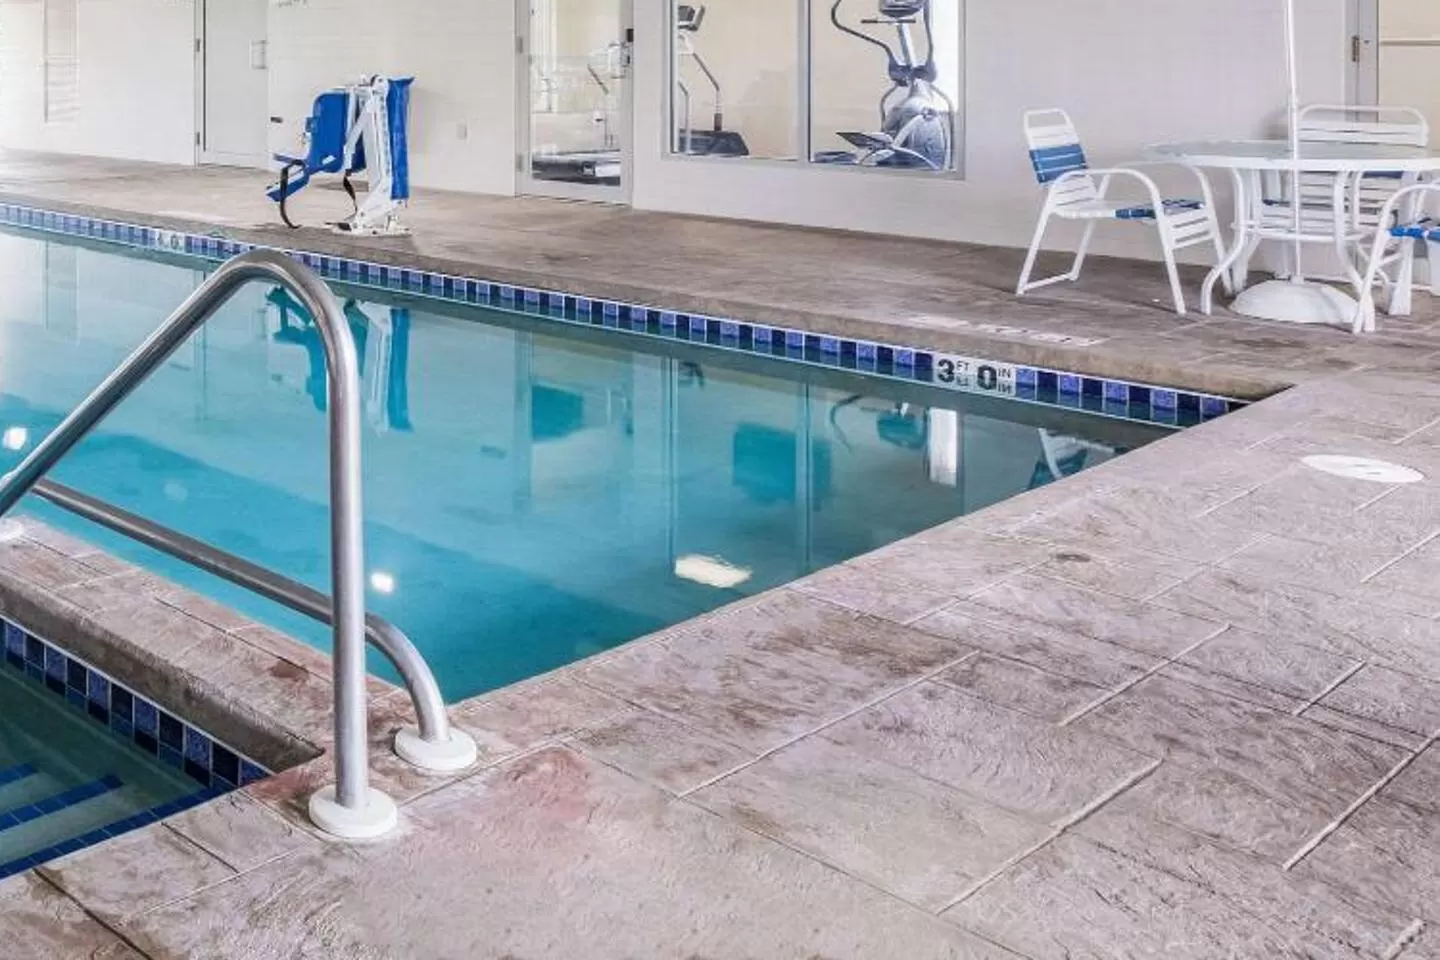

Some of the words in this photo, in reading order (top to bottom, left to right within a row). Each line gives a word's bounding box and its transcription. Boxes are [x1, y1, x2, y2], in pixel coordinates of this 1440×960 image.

[937, 358, 955, 383] 3
[957, 360, 970, 372] FT
[977, 365, 997, 390] 0
[998, 368, 1011, 379] IN
